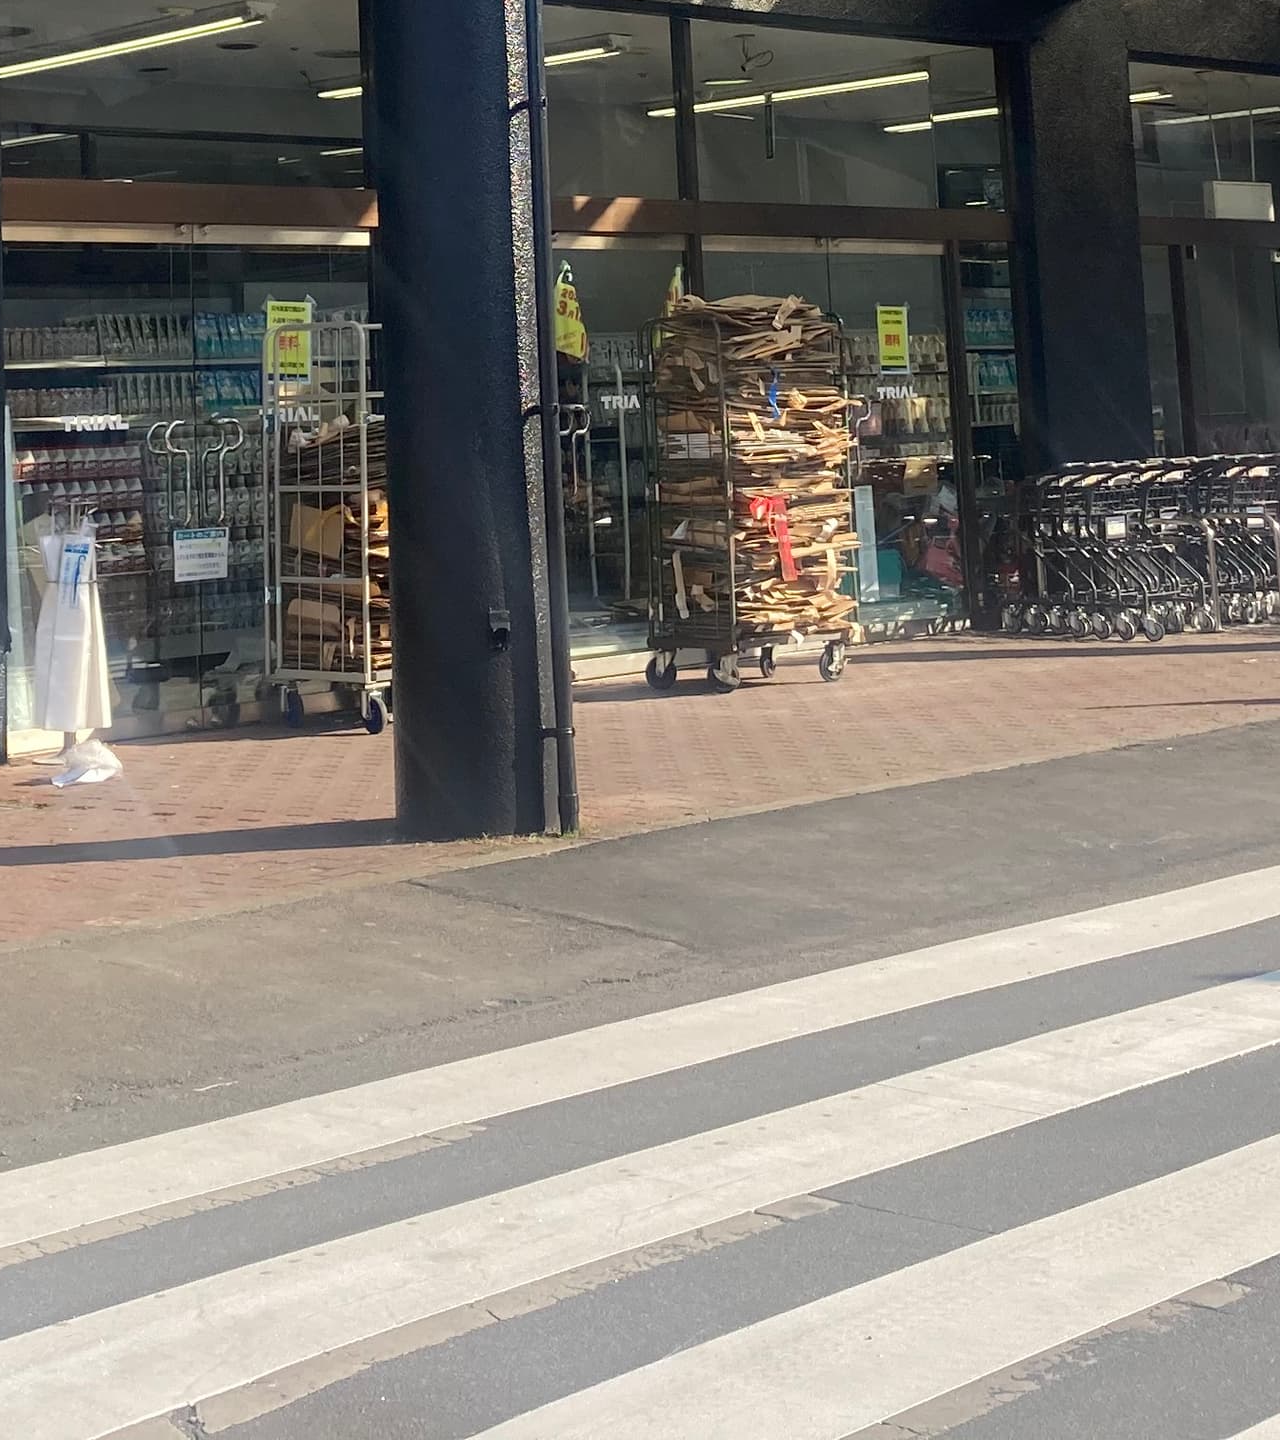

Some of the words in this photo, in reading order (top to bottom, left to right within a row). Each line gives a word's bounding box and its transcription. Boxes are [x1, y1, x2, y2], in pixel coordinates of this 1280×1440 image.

[877, 386, 918, 400] TRIAL
[601, 395, 641, 409] TRIA
[61, 415, 130, 432] TRIAL
